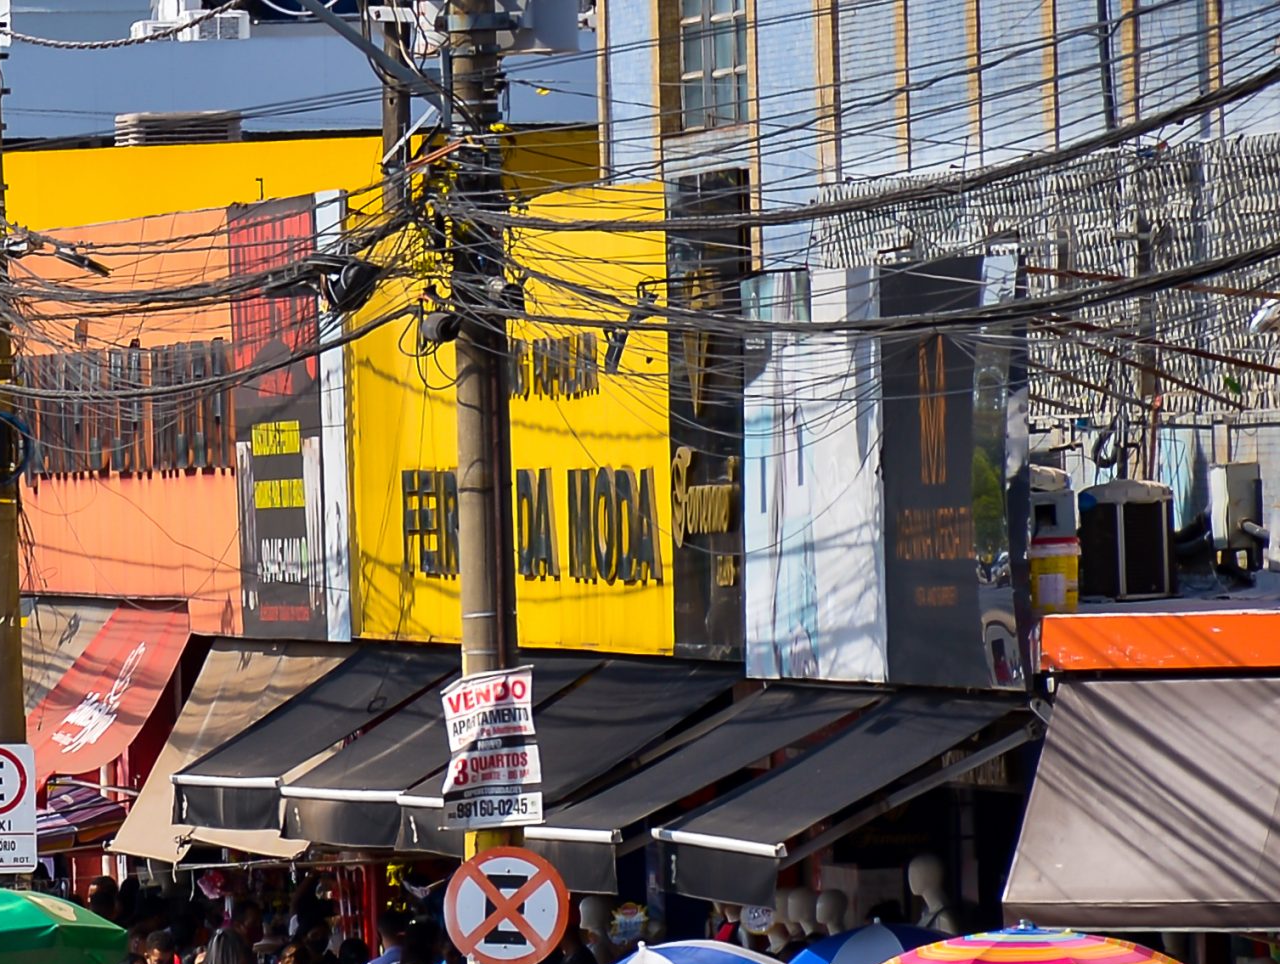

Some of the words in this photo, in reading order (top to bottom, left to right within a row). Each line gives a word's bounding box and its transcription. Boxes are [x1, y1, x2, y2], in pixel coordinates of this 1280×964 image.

[516, 468, 560, 580] DA
[567, 467, 664, 584] MODA
[448, 679, 527, 714] VENDO
[454, 759, 469, 785] 3
[471, 751, 528, 773] QUARTOS
